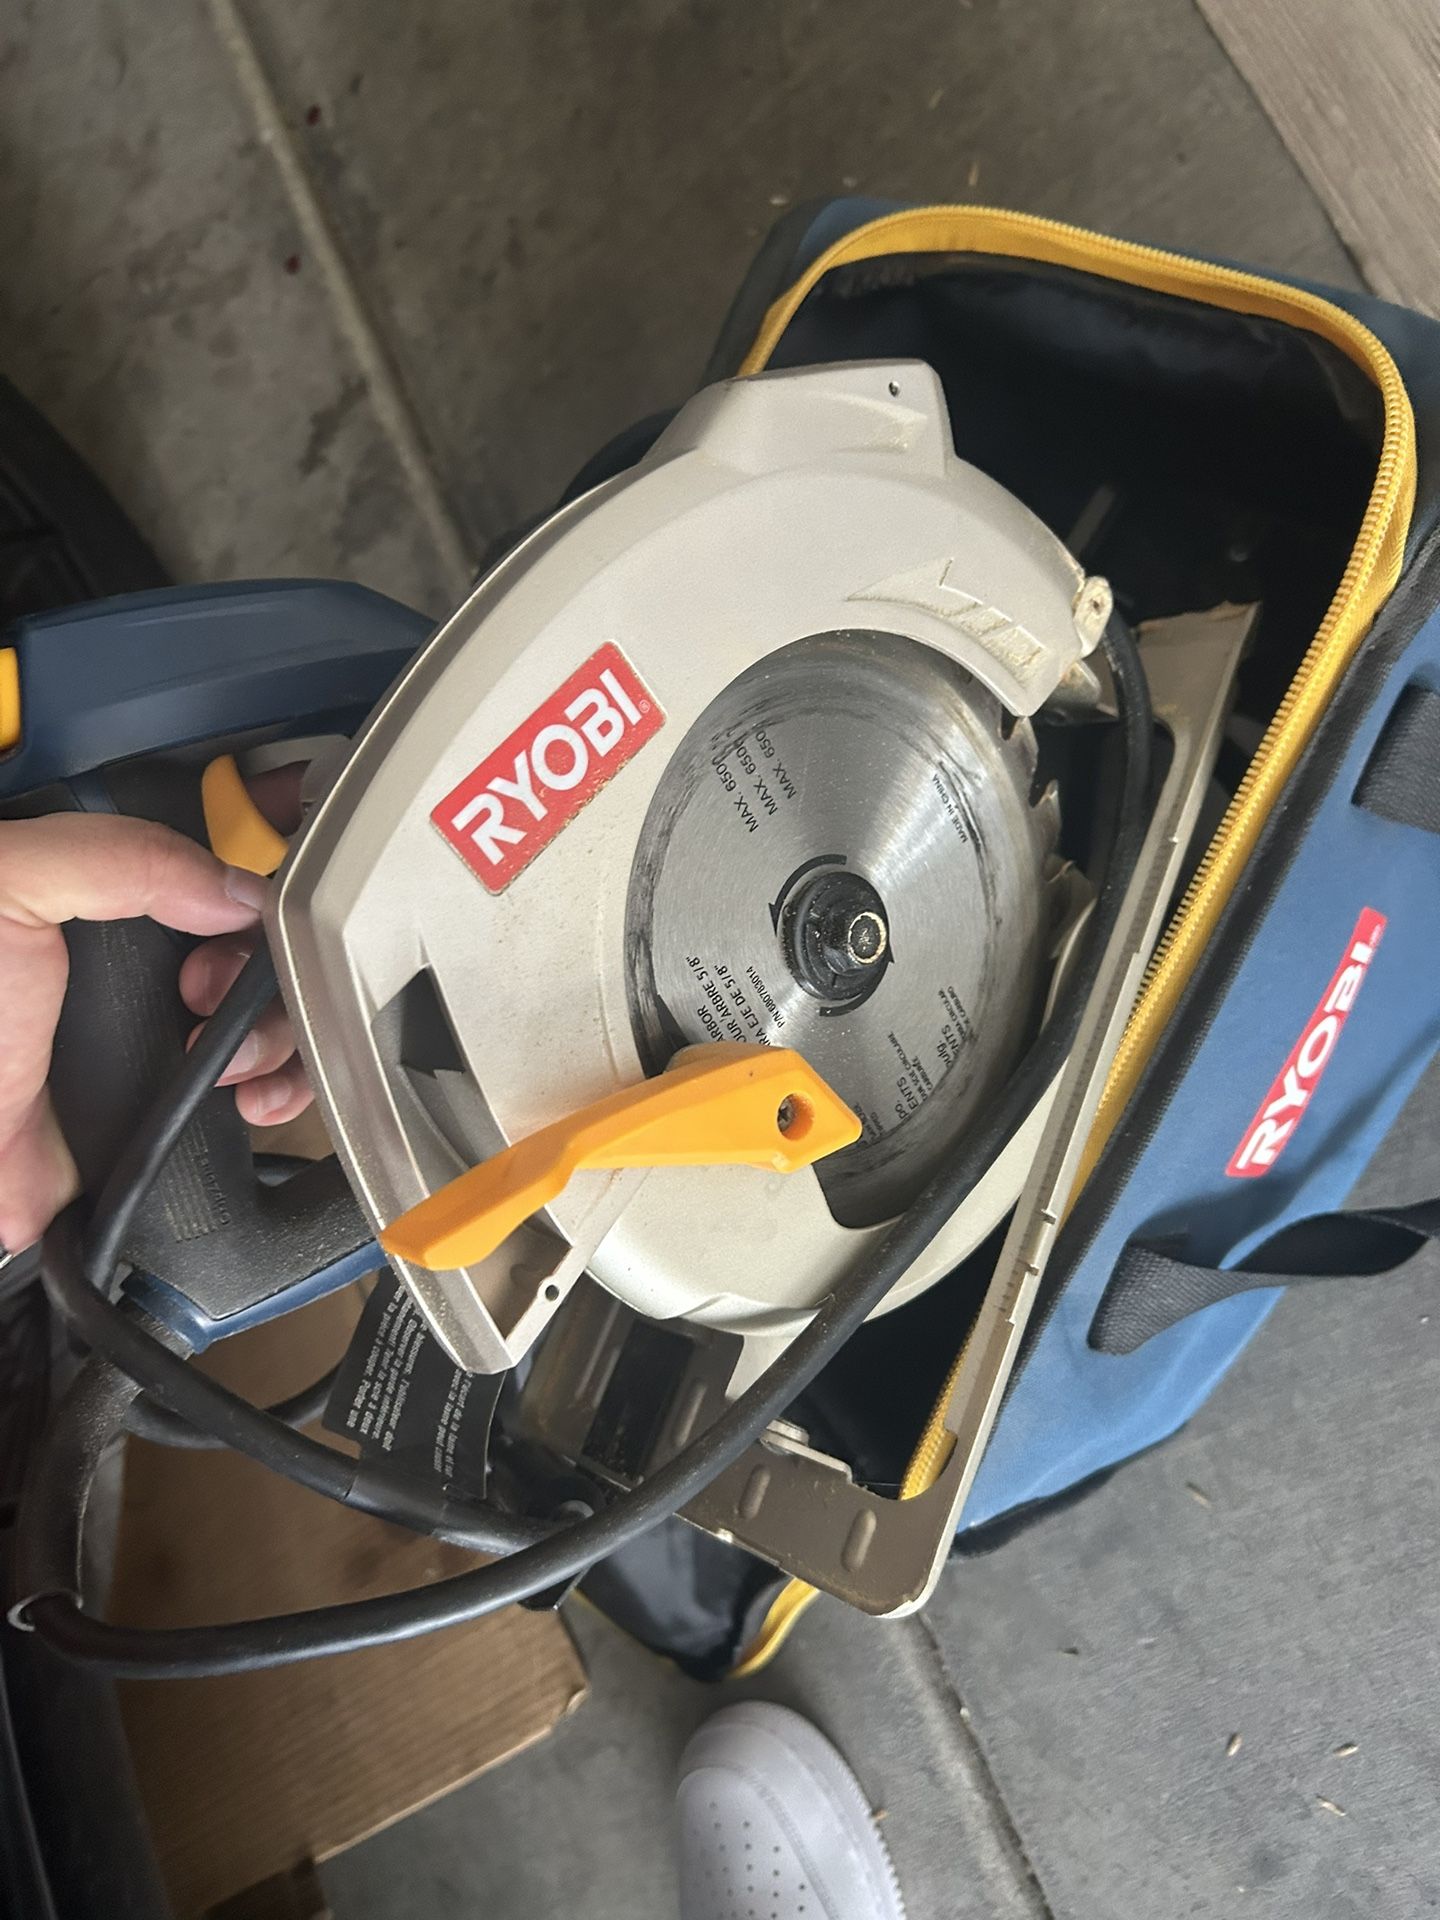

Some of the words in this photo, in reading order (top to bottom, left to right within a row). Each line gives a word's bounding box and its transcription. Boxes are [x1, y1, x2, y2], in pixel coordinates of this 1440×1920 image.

[451, 668, 642, 865] RYOBI
[772, 759, 796, 798] MAX.
[753, 775, 777, 814] MAX.
[932, 773, 950, 804] CHINA
[733, 791, 758, 831] MAX.
[946, 803, 954, 815] IN
[951, 814, 968, 843] MADE
[730, 988, 745, 1006] DE
[697, 1005, 724, 1041] ARBOR
[741, 1006, 758, 1028] EJE
[756, 1028, 770, 1045] RA
[1236, 941, 1373, 1170] RYOBI
[370, 1381, 382, 1400] scie
[358, 1410, 374, 1434] deux
[381, 1430, 394, 1451] doit
